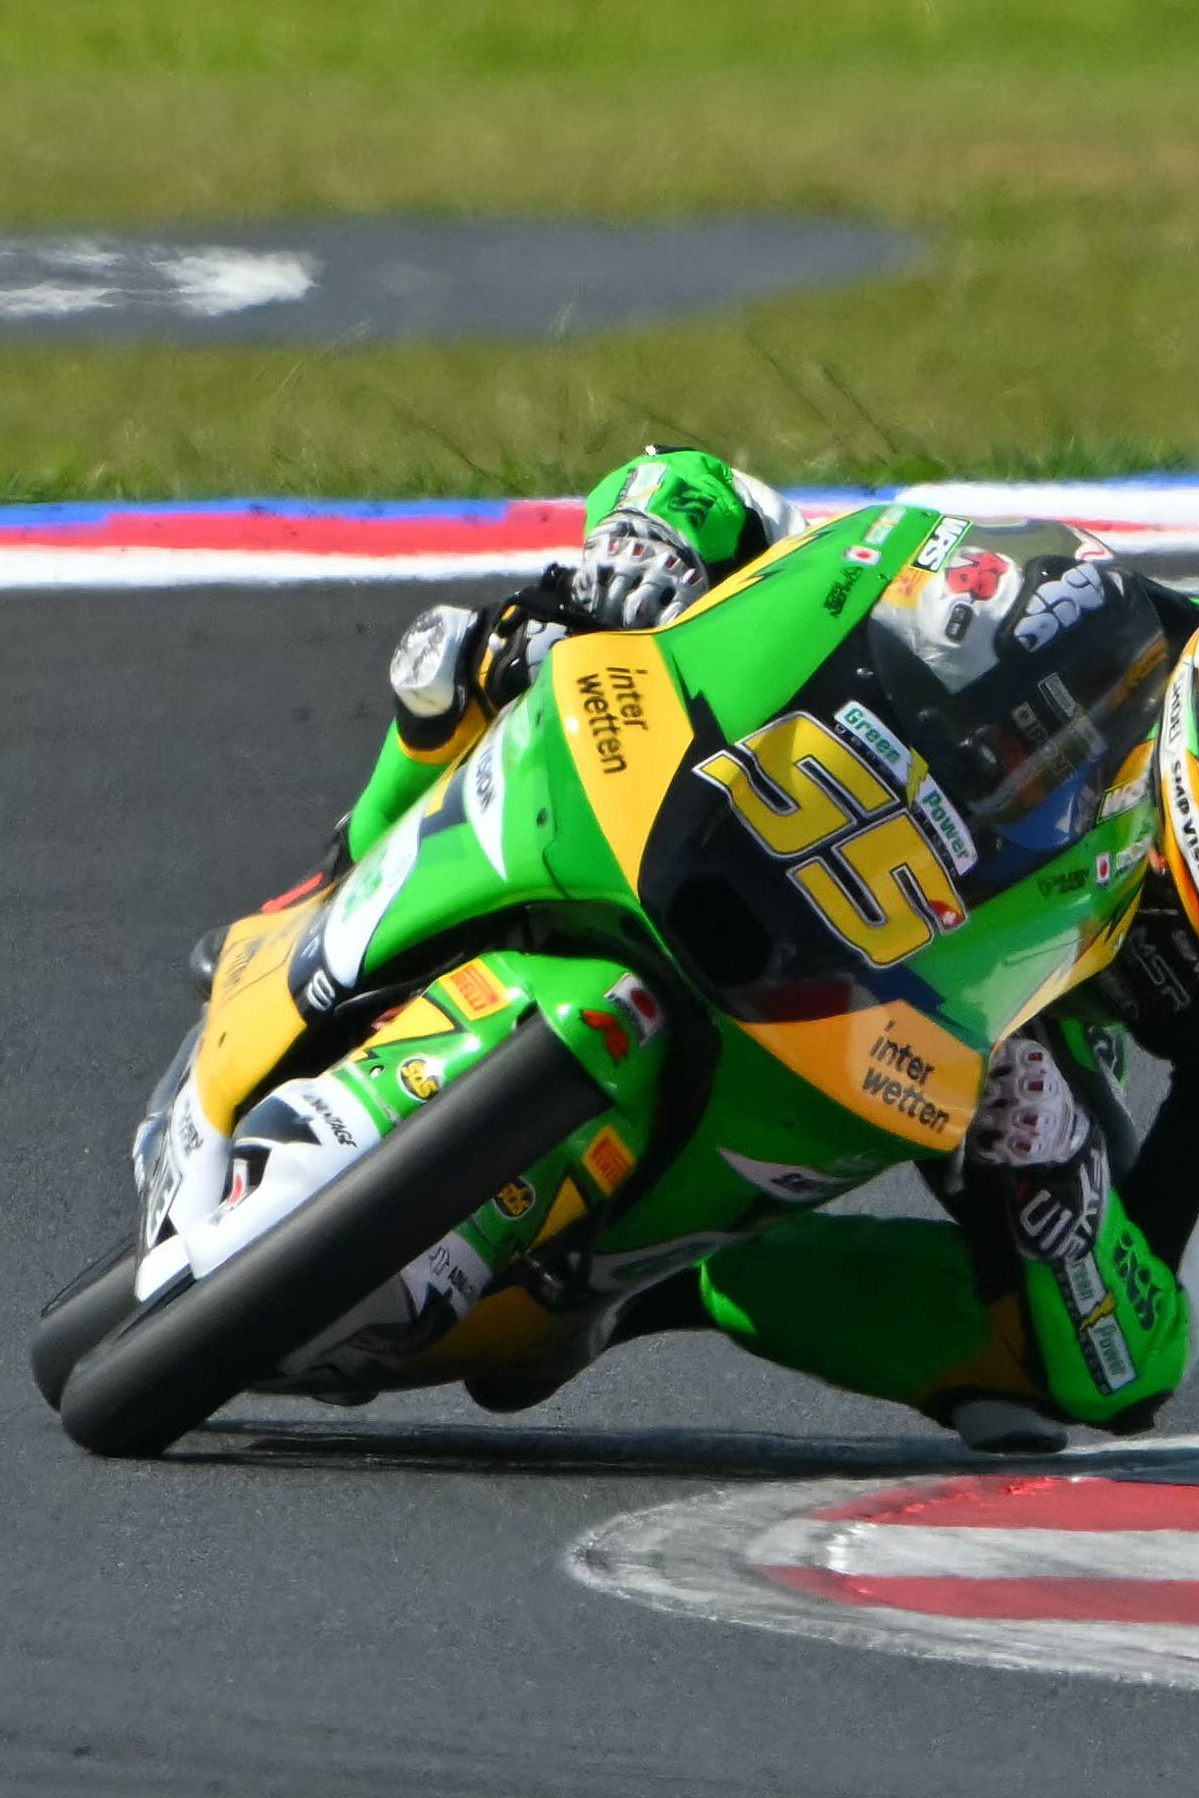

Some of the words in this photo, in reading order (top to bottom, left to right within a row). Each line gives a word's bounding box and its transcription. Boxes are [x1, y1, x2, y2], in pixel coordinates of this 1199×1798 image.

[577, 674, 627, 774] wetten
[606, 667, 648, 730] inter
[844, 708, 900, 764] Green
[922, 790, 968, 860] Power
[693, 711, 967, 967] 55
[870, 1020, 935, 1085] inter
[863, 1067, 949, 1132] wetten
